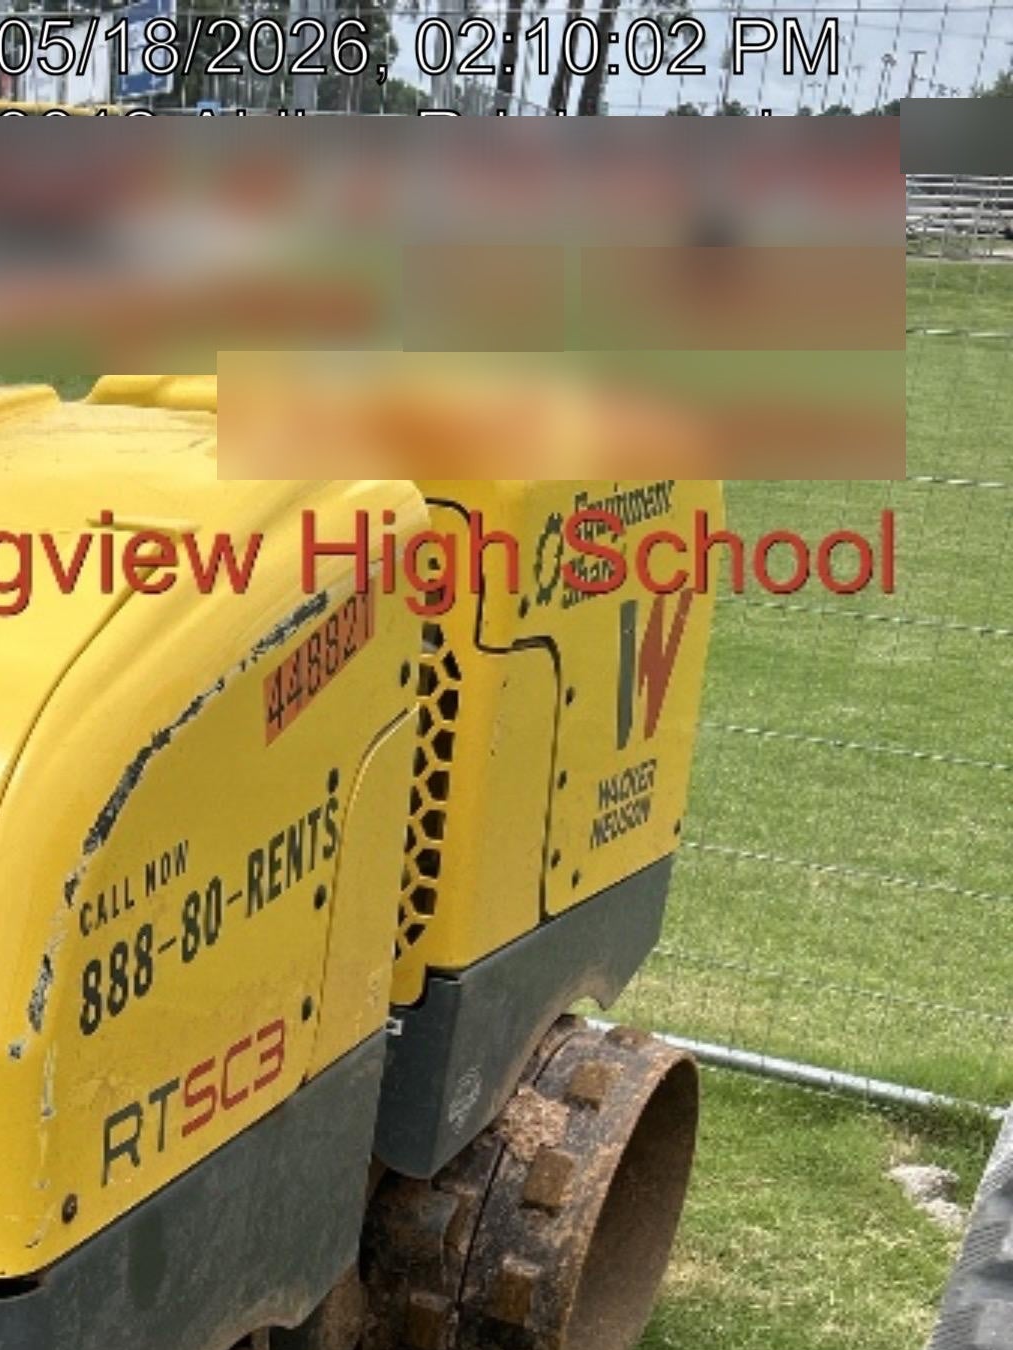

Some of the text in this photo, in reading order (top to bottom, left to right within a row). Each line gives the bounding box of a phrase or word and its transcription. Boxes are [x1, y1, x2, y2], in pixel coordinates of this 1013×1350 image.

[268, 592, 370, 730] 448821
[79, 839, 188, 937] CALL NOW
[79, 797, 339, 1037] 888-80-RENTS
[101, 1016, 286, 1188] RTSC3
